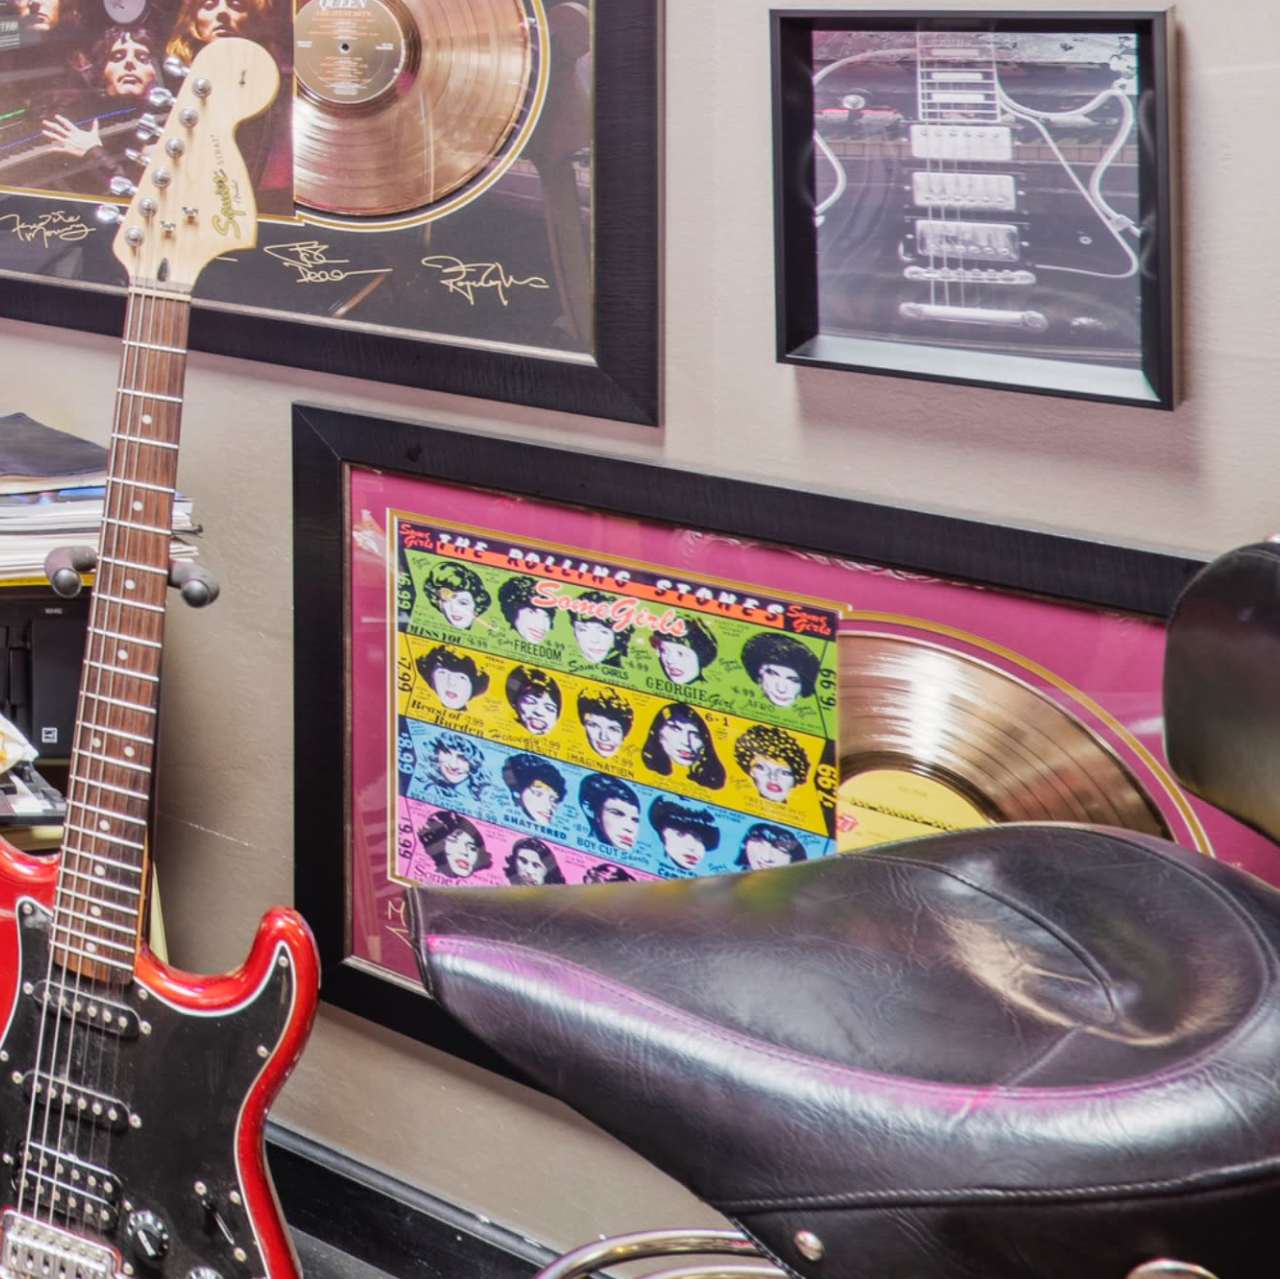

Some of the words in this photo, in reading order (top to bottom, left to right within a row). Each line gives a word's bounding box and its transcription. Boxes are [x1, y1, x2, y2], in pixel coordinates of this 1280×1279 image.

[438, 533, 488, 558] THE
[507, 548, 631, 588] ROLLING
[655, 579, 785, 622] STONES
[531, 581, 609, 619] Some
[608, 596, 688, 637] Girls
[514, 640, 562, 662] FREEDOM
[645, 677, 707, 702] GEORGIE
[411, 699, 447, 719] Beast
[433, 715, 484, 738] Burden
[503, 814, 568, 841] SHATTERED
[576, 837, 597, 853] BOY
[597, 843, 620, 859] CUT
